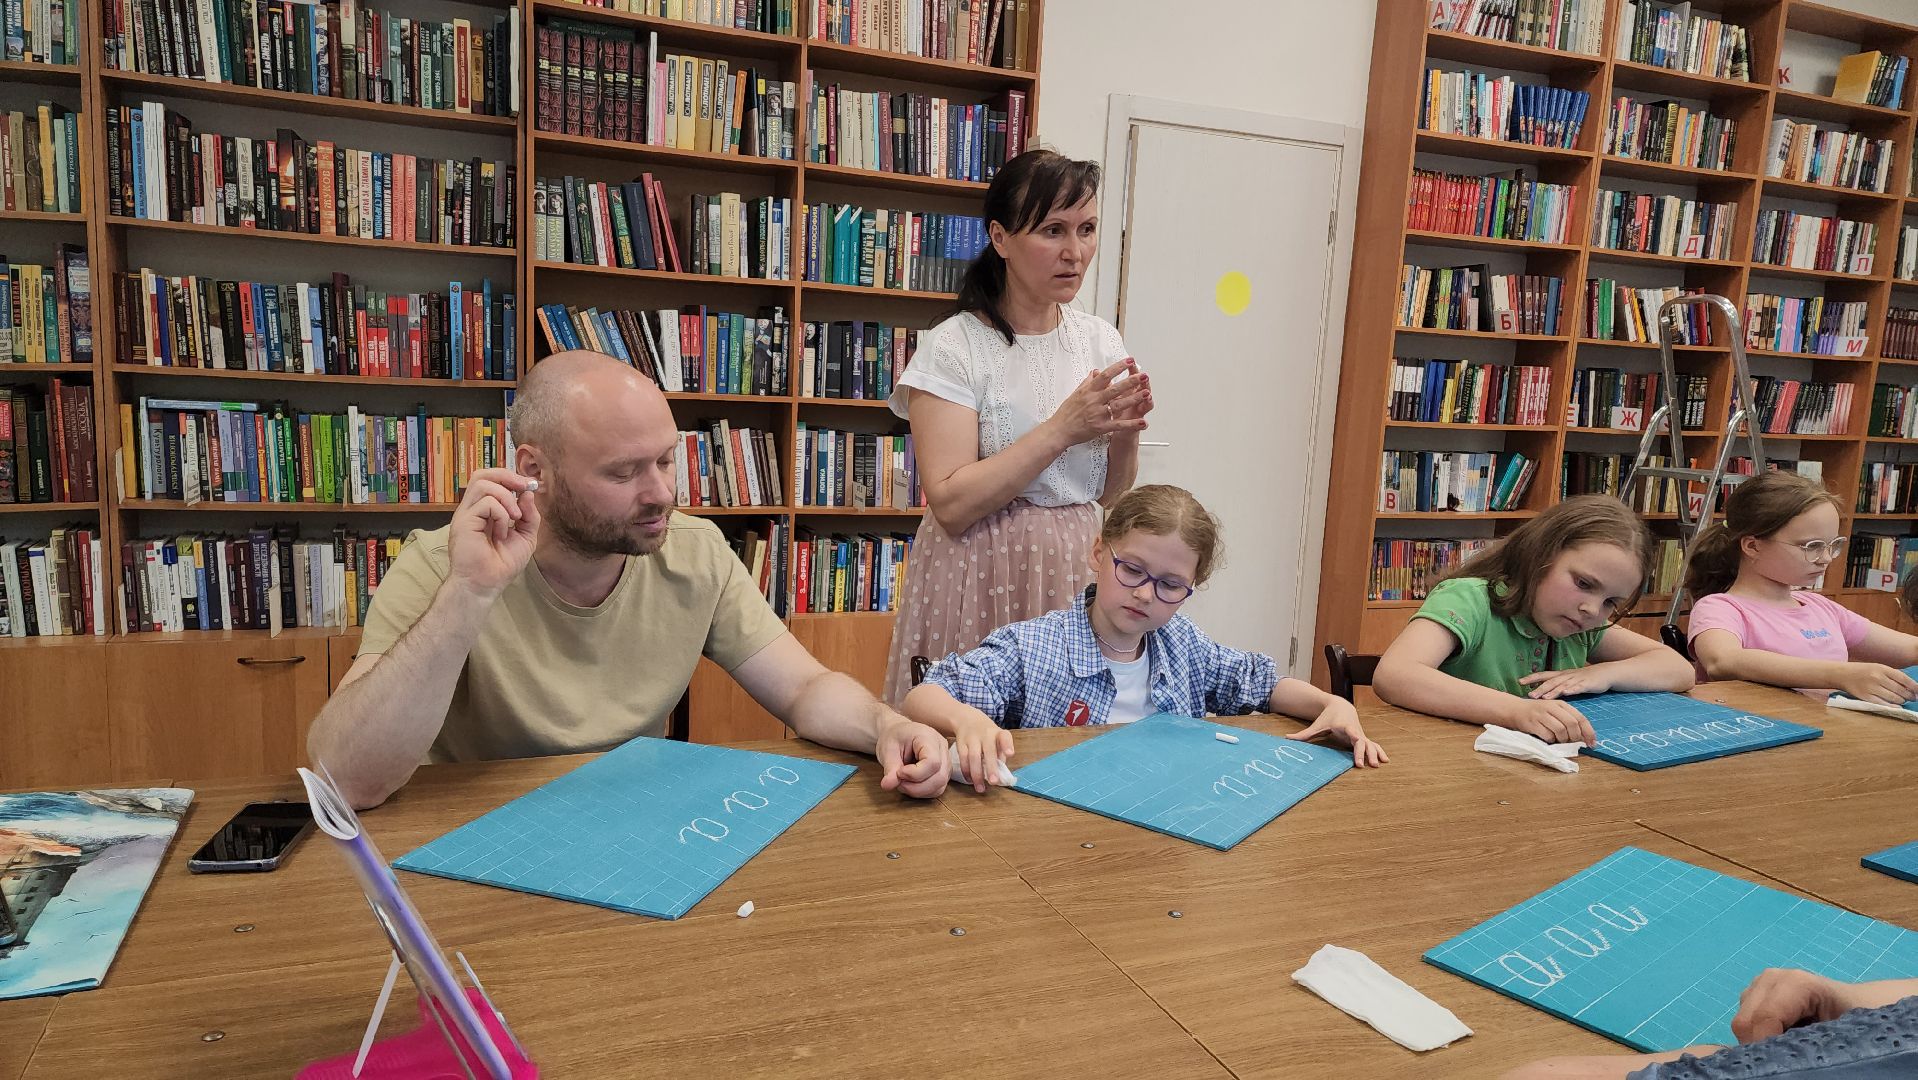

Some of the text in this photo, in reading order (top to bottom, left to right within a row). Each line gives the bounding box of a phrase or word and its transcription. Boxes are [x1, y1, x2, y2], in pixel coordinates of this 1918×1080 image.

[1432, 3, 1446, 22] А
[1777, 66, 1791, 85] К
[383, 157, 392, 187] АВТОМАТ
[464, 164, 473, 195] АВТОМАТ
[322, 170, 332, 210] ЖУКОВ
[811, 206, 819, 260] ФИЛОСОФИЯ
[1683, 237, 1698, 257] Д
[1854, 256, 1869, 272] Л
[1500, 313, 1512, 331] Б
[1845, 339, 1863, 354] М
[77, 401, 88, 435] МОСКВА
[1619, 409, 1638, 428] Ж
[152, 428, 164, 485] Культурология
[278, 425, 287, 466] ПЕДАГОГИКА
[168, 435, 179, 490] КУЛЬТУРОЛОГИЯ
[836, 439, 845, 498] ЭТИКА ЭСТЕТИКА
[819, 468, 827, 494] ЛОГИКА
[1385, 493, 1397, 510] В
[1688, 496, 1703, 513] И
[367, 544, 377, 585] РИТОРИКА
[800, 548, 808, 581] ФРЕЙД
[1881, 573, 1894, 586] Р
